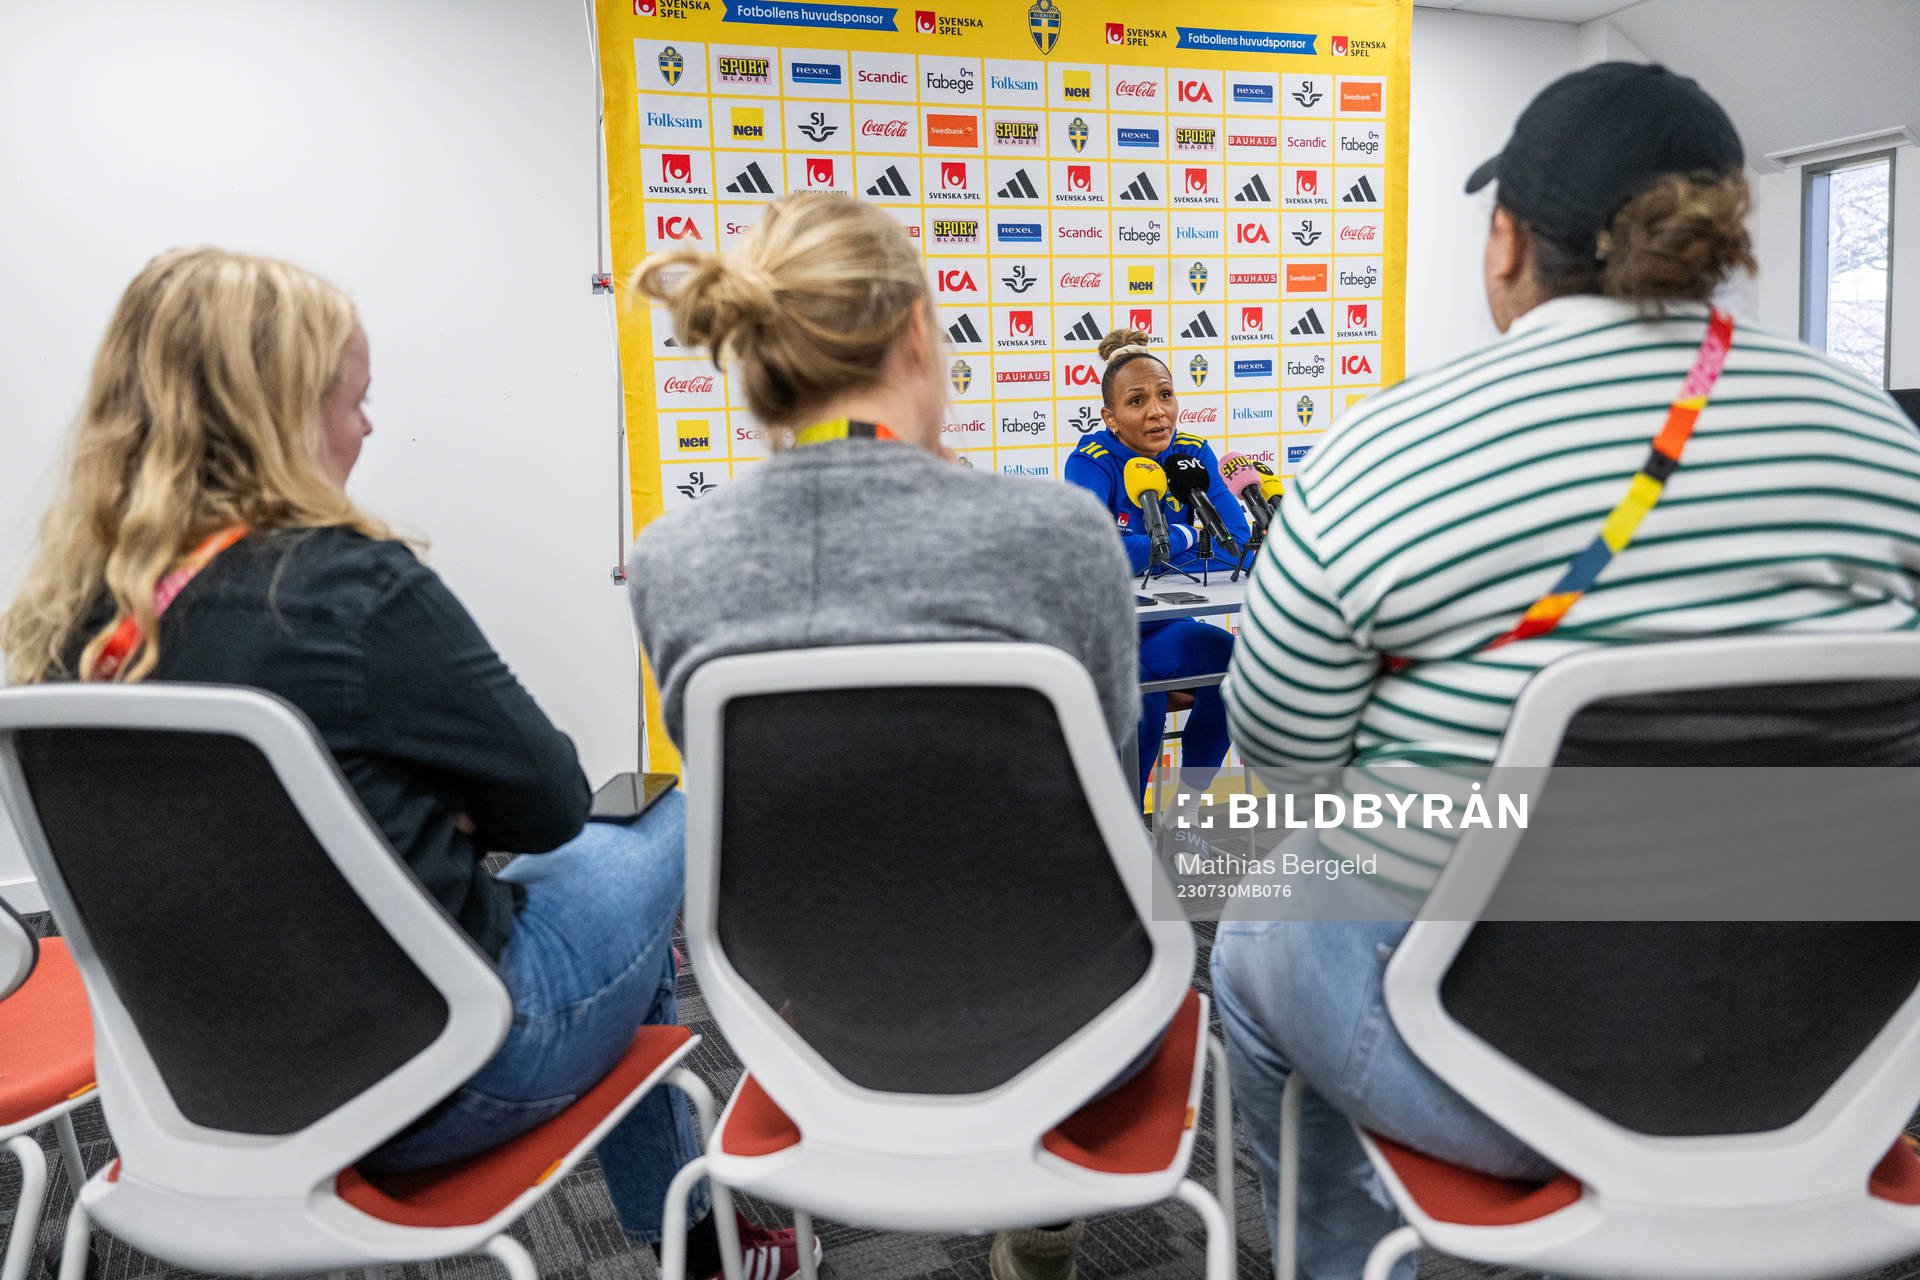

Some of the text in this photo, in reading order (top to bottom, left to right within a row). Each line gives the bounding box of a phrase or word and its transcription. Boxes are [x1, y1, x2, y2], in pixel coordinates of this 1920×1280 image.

[660, 0, 711, 10] SVENSKA
[660, 9, 687, 19] SPEL
[737, 5, 884, 24] Fotbollens huvudsponsor
[939, 16, 983, 27] SVENSKA
[939, 26, 963, 35] SPEL
[1127, 28, 1167, 38] SVENSKA
[1127, 37, 1149, 46] SPEL
[1188, 32, 1306, 49] Fotbollens huvudsponsor
[1350, 40, 1386, 49] SVENSKA
[719, 58, 769, 77] SPORT
[858, 70, 908, 84] Scandic
[927, 73, 974, 94] Fabege
[991, 75, 1038, 91] Folksam
[1116, 80, 1159, 97] Coca-Cola
[1178, 81, 1213, 103] ICA
[1302, 81, 1313, 93] SJ
[647, 112, 703, 128] Folksam
[810, 112, 825, 126] SJ
[862, 119, 910, 137] Coca-Cola
[930, 127, 964, 135] Swedbank
[995, 123, 1038, 140] SPORT
[1176, 129, 1215, 145] SPORT
[1229, 136, 1276, 146] BAUHAUS
[1288, 137, 1327, 147] Scandic
[1341, 137, 1379, 154] Fabege
[649, 186, 708, 195] SVENSKA SPEL
[657, 216, 703, 240] ICA
[934, 221, 978, 237] SPORT
[1058, 227, 1103, 238] Scandic
[1176, 227, 1219, 239] Folksam
[1237, 223, 1271, 243] ICA
[1301, 221, 1312, 233] SJ
[1340, 225, 1377, 240] Coca-Cola
[1119, 227, 1160, 245] Fabege
[1013, 266, 1025, 278] SJ
[1230, 274, 1276, 283] BAUHAUS
[938, 270, 978, 292] ICA
[1060, 272, 1103, 289] Coca-Cola
[1340, 272, 1377, 288] Fabege
[998, 337, 1047, 347] SVENSKA SPEL
[1288, 361, 1325, 378] Fabege
[1341, 355, 1372, 375] ICA
[997, 372, 1049, 382] BAUHAUS
[1065, 364, 1101, 386] ICA
[663, 376, 715, 393] Coca-Cola
[1079, 407, 1091, 419] SJ
[1179, 407, 1218, 424] Coca-Cola
[1233, 408, 1272, 420] Folksam
[941, 420, 986, 433] Scandic
[1002, 418, 1046, 435] Fabege
[1246, 451, 1275, 462] andic
[1004, 465, 1049, 476] Folksam
[689, 472, 704, 485] SJ
[1174, 830, 1209, 854] SWE
